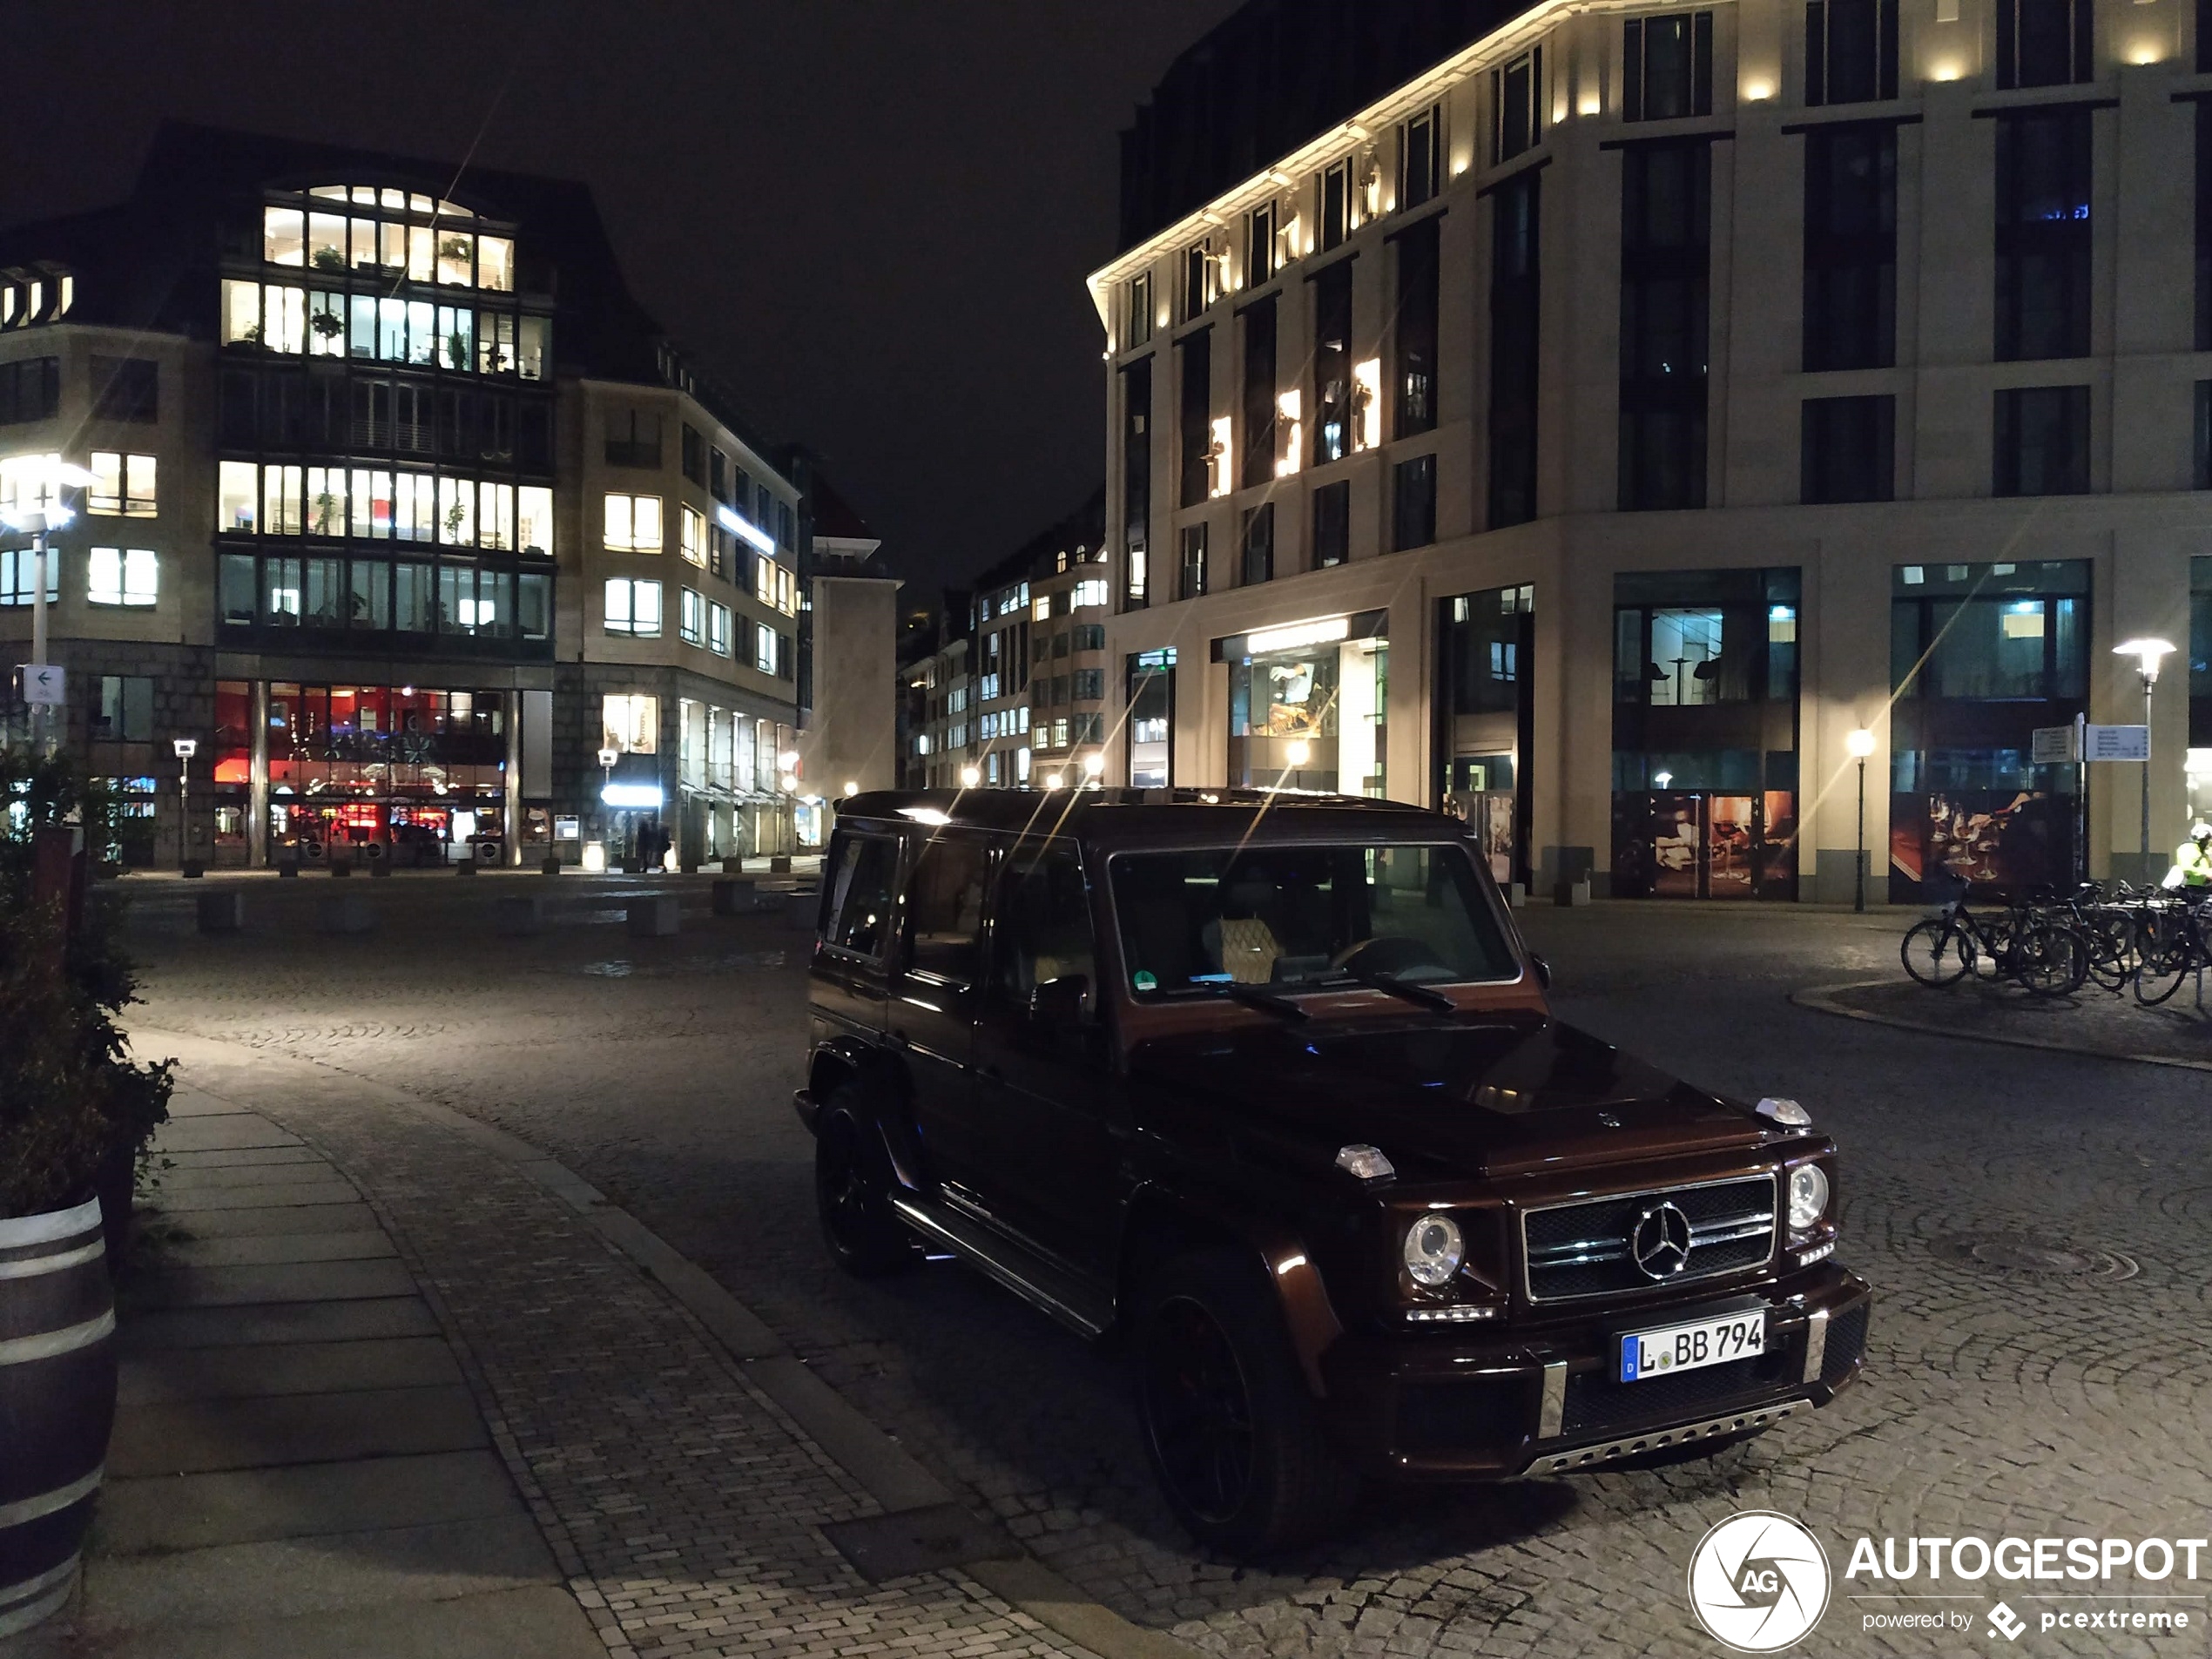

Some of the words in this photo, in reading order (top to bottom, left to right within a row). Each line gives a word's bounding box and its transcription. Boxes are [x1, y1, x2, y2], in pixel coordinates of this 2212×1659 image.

[1639, 1340, 1656, 1373] L
[1676, 1330, 1709, 1366] BB
[1716, 1318, 1762, 1358] 794
[1627, 1363, 1634, 1373] D
